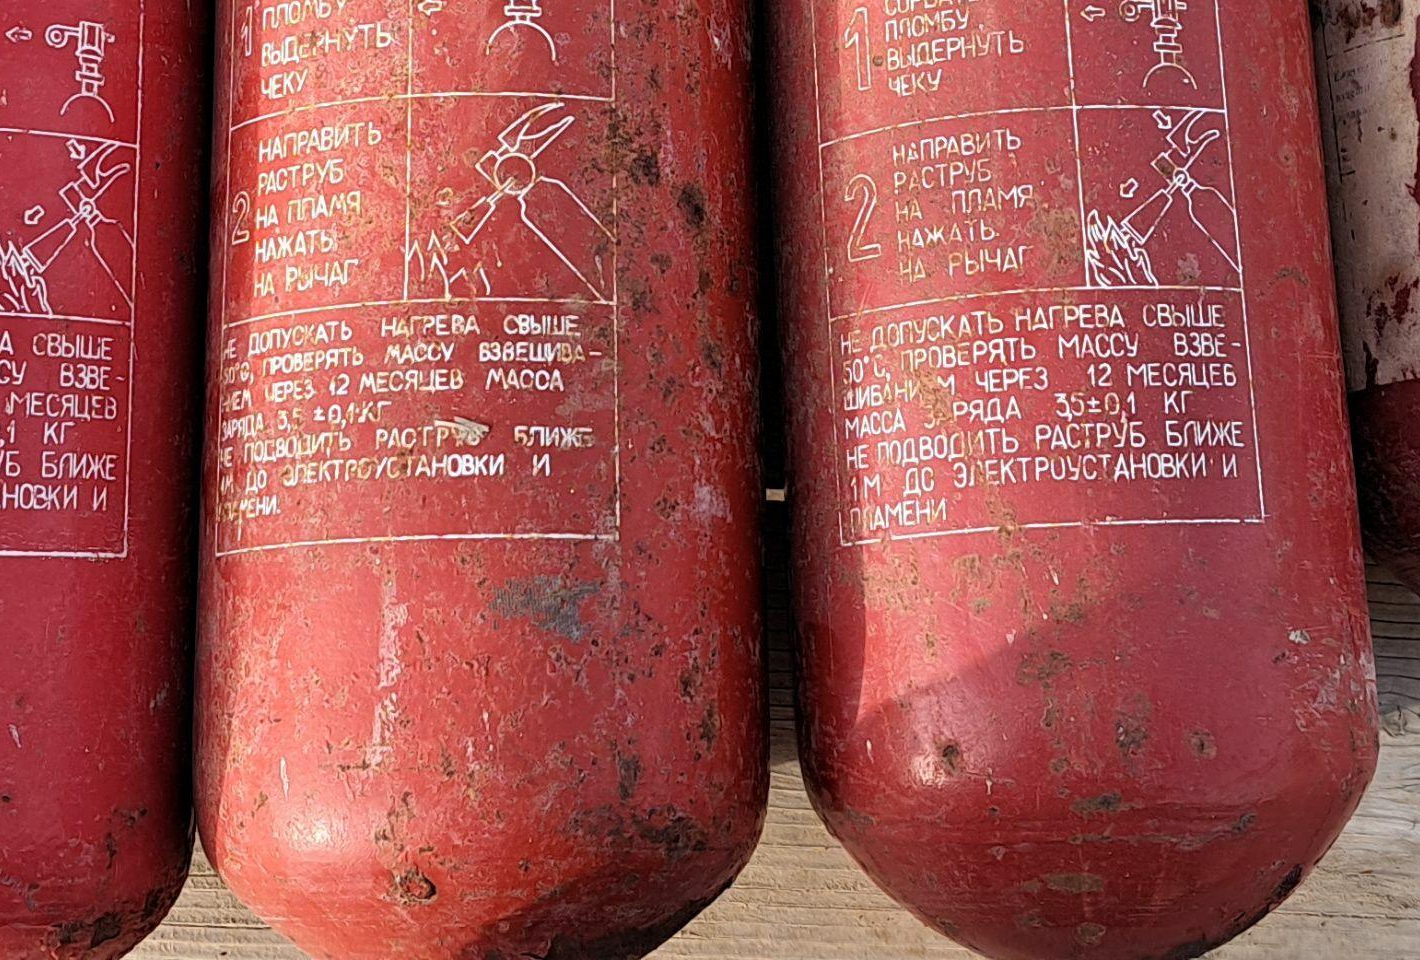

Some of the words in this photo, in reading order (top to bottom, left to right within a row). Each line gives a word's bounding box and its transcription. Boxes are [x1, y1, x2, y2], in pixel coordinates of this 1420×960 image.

[884, 9, 970, 40] ПЛОМБУ
[844, 7, 872, 90] 1
[886, 30, 1024, 72] ВЫДЕРНУТЬ
[261, 69, 308, 100] ЧЕКУ
[888, 69, 942, 97] ЧЕКУ
[259, 121, 382, 163] НАПРАВИТЬ
[258, 159, 344, 196] РАСТРУБ
[894, 158, 992, 195] РАСТРУБ
[844, 174, 882, 263] 2
[893, 129, 1022, 165] НАПРАВИТЬ
[896, 198, 922, 219] НА
[256, 206, 279, 228] НА
[899, 259, 926, 283] НА
[948, 245, 1033, 276] РЫЧАГ
[254, 275, 275, 297] НА
[841, 329, 861, 358] НЕ
[1015, 304, 1124, 331] НАГРЕВА
[1143, 304, 1225, 328] СВЫШЕ
[33, 334, 113, 360] СВЫШЕ
[1058, 333, 1139, 360] МАССУ
[1086, 364, 1112, 388] 12
[9, 392, 116, 422] МЕСЯЦЕВ
[845, 409, 905, 439] МАССА
[1164, 391, 1194, 414] КГ
[44, 421, 76, 445] КГ
[847, 444, 869, 471] НЕ
[1036, 421, 1146, 449] РАСТРУБ
[1165, 420, 1245, 448] БЛИЖЕ
[42, 452, 116, 481] БЛИЖЕ
[533, 454, 551, 477] И
[1222, 456, 1237, 478] И
[92, 486, 107, 510] И
